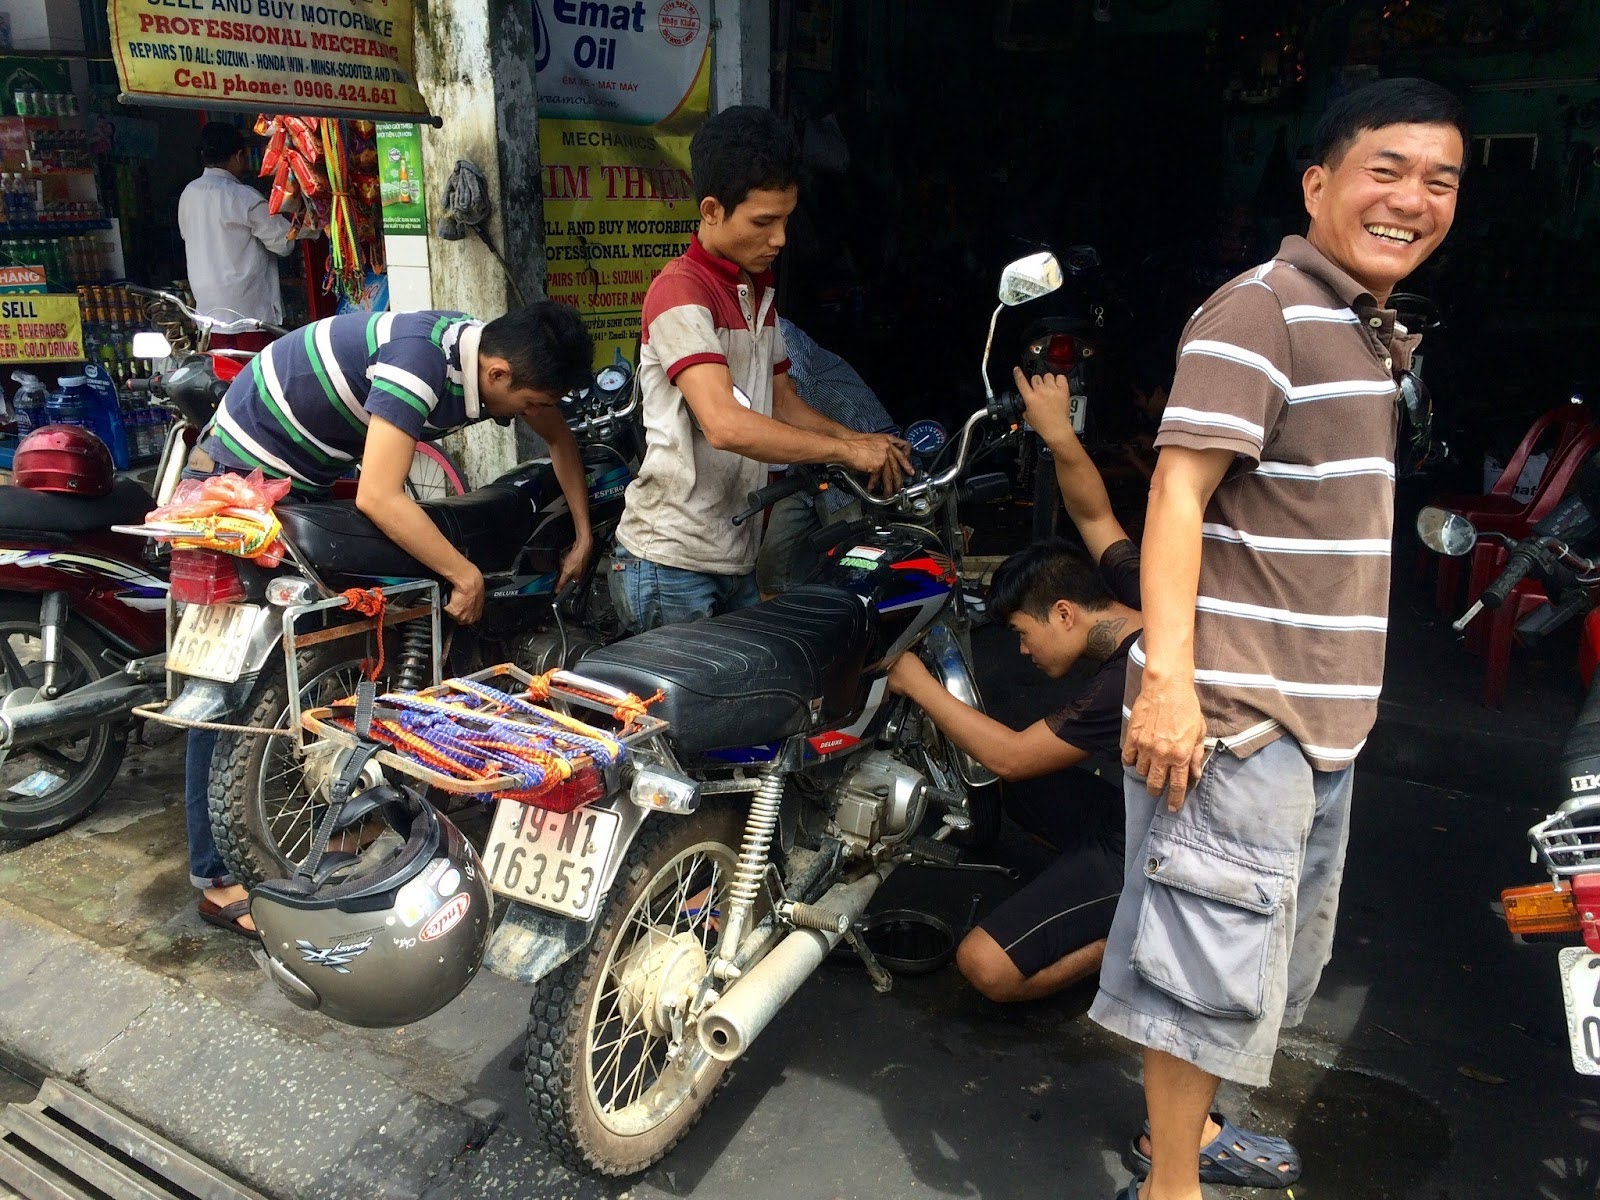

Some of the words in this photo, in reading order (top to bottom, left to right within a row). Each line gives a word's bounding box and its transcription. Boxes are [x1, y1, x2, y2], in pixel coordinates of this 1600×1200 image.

[258, 0, 293, 20] BUY
[553, 0, 647, 33] Emat
[139, 13, 307, 48] PROFESSIONAL
[128, 41, 177, 62] REPAIRS
[179, 45, 193, 62] TO
[195, 47, 214, 65] ALL:
[216, 50, 249, 69] SUZUKI
[257, 53, 285, 72] HONDA
[287, 55, 304, 73] WIN
[310, 59, 373, 80] MINSK-SCOOTER
[375, 66, 390, 82] AND
[573, 35, 616, 70] Oil
[174, 68, 217, 90] Cell
[223, 74, 288, 96] phone:
[294, 79, 398, 105] 0906.424.641
[562, 131, 657, 150] MECHANICS
[541, 164, 593, 200] IM
[566, 220, 596, 235] AND
[599, 220, 624, 235] BUY
[546, 244, 629, 261] OFESSIONAL
[632, 243, 691, 259] MECHAN
[547, 272, 573, 287] PAIRS
[576, 272, 587, 286] TO
[612, 270, 643, 285] SUZUKI
[588, 292, 628, 308] SCOOTER
[2, 301, 38, 319] SELL
[18, 322, 67, 339] BEVERAGES
[24, 343, 47, 359] COLD
[48, 341, 79, 357] DRINKS
[594, 485, 625, 499] ESPERO
[820, 738, 843, 748] DELUXE
[490, 842, 595, 910] 163.53
